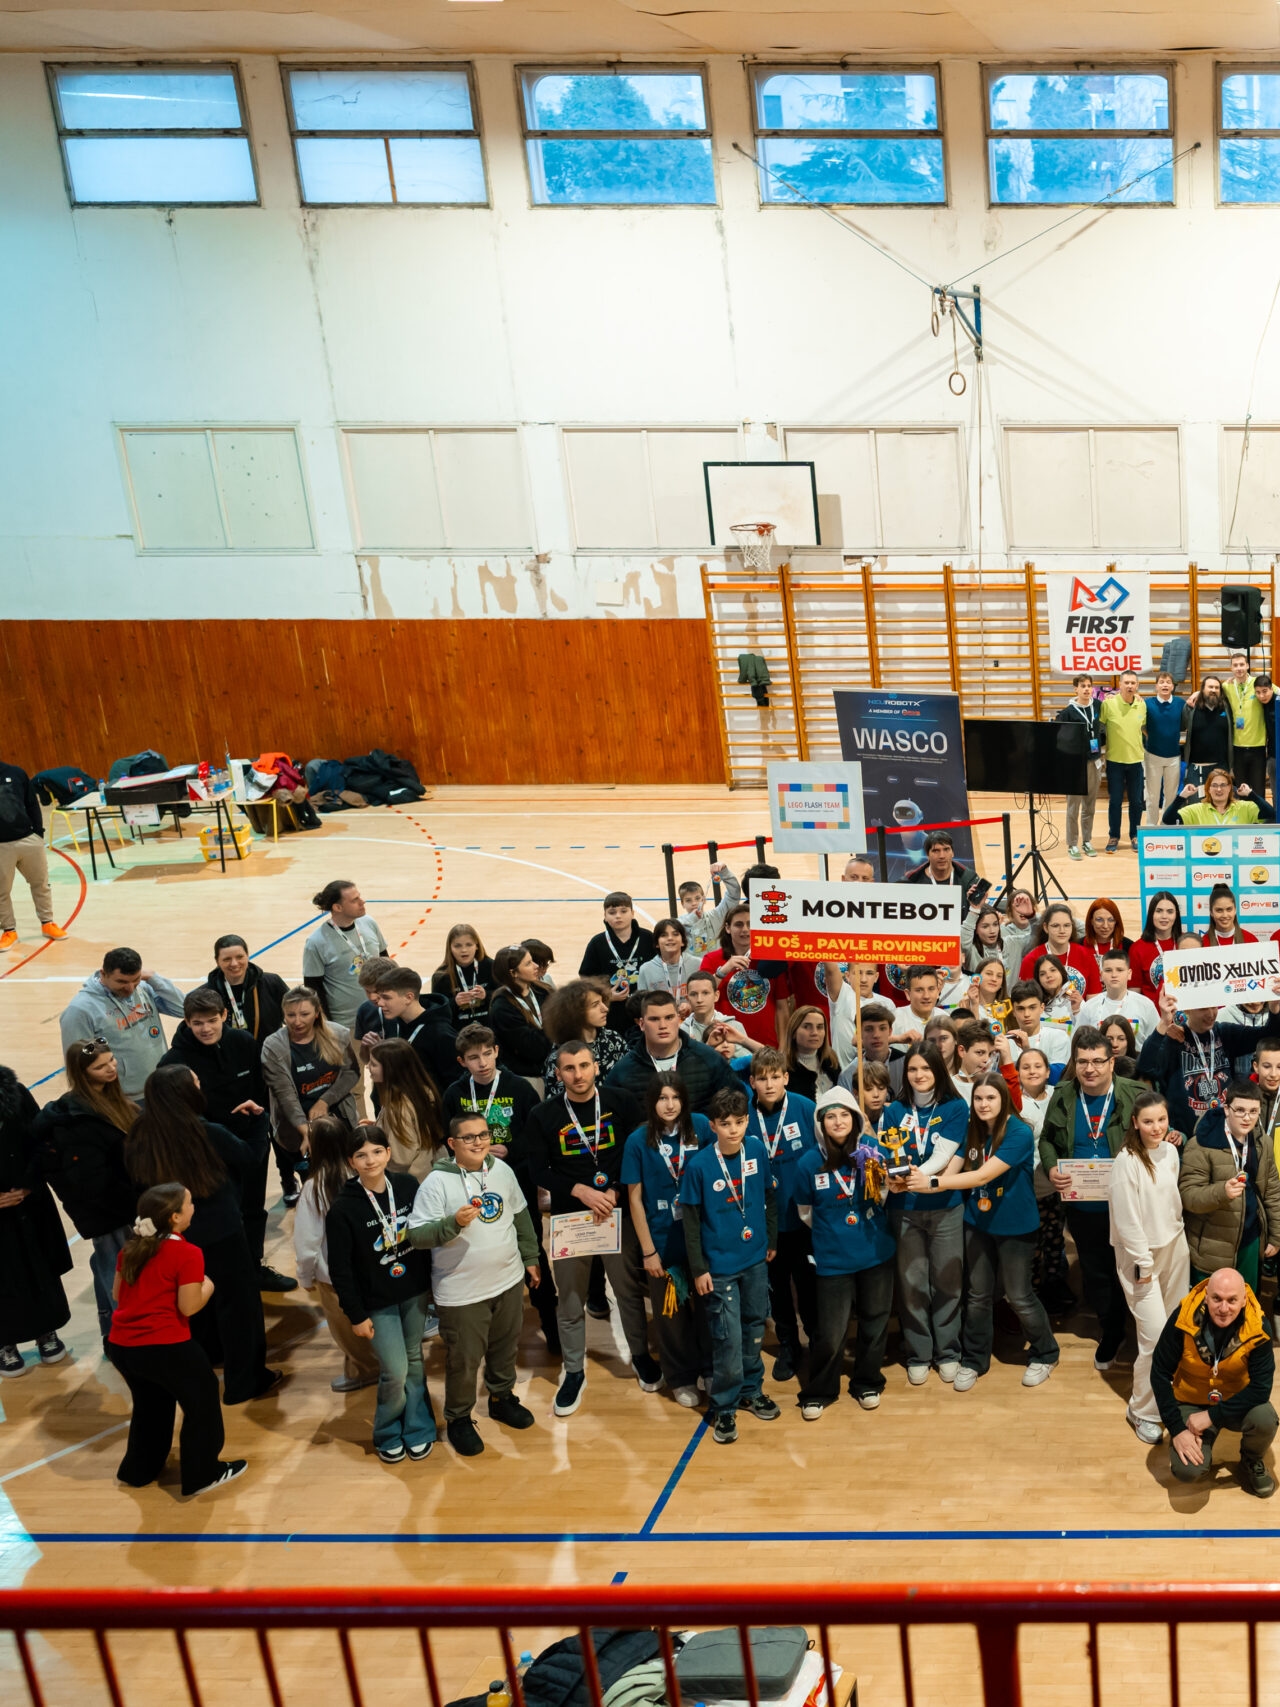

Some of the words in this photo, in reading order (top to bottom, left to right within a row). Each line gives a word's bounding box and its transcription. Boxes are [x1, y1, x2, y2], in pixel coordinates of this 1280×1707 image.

[1065, 616, 1134, 634] FIRST
[1071, 636, 1127, 652] LEGO
[1061, 655, 1142, 671] LEAGUE
[852, 727, 948, 755] WASCO
[802, 900, 954, 920] MONTEBOT
[754, 936, 774, 947] JU
[778, 935, 800, 948] OŠ
[817, 939, 868, 951] PAVLE
[785, 951, 846, 961] PODGORICA
[855, 954, 926, 963] MONTENEGRO
[1179, 962, 1221, 983] SQUAD
[1223, 958, 1280, 981] SYNTAX
